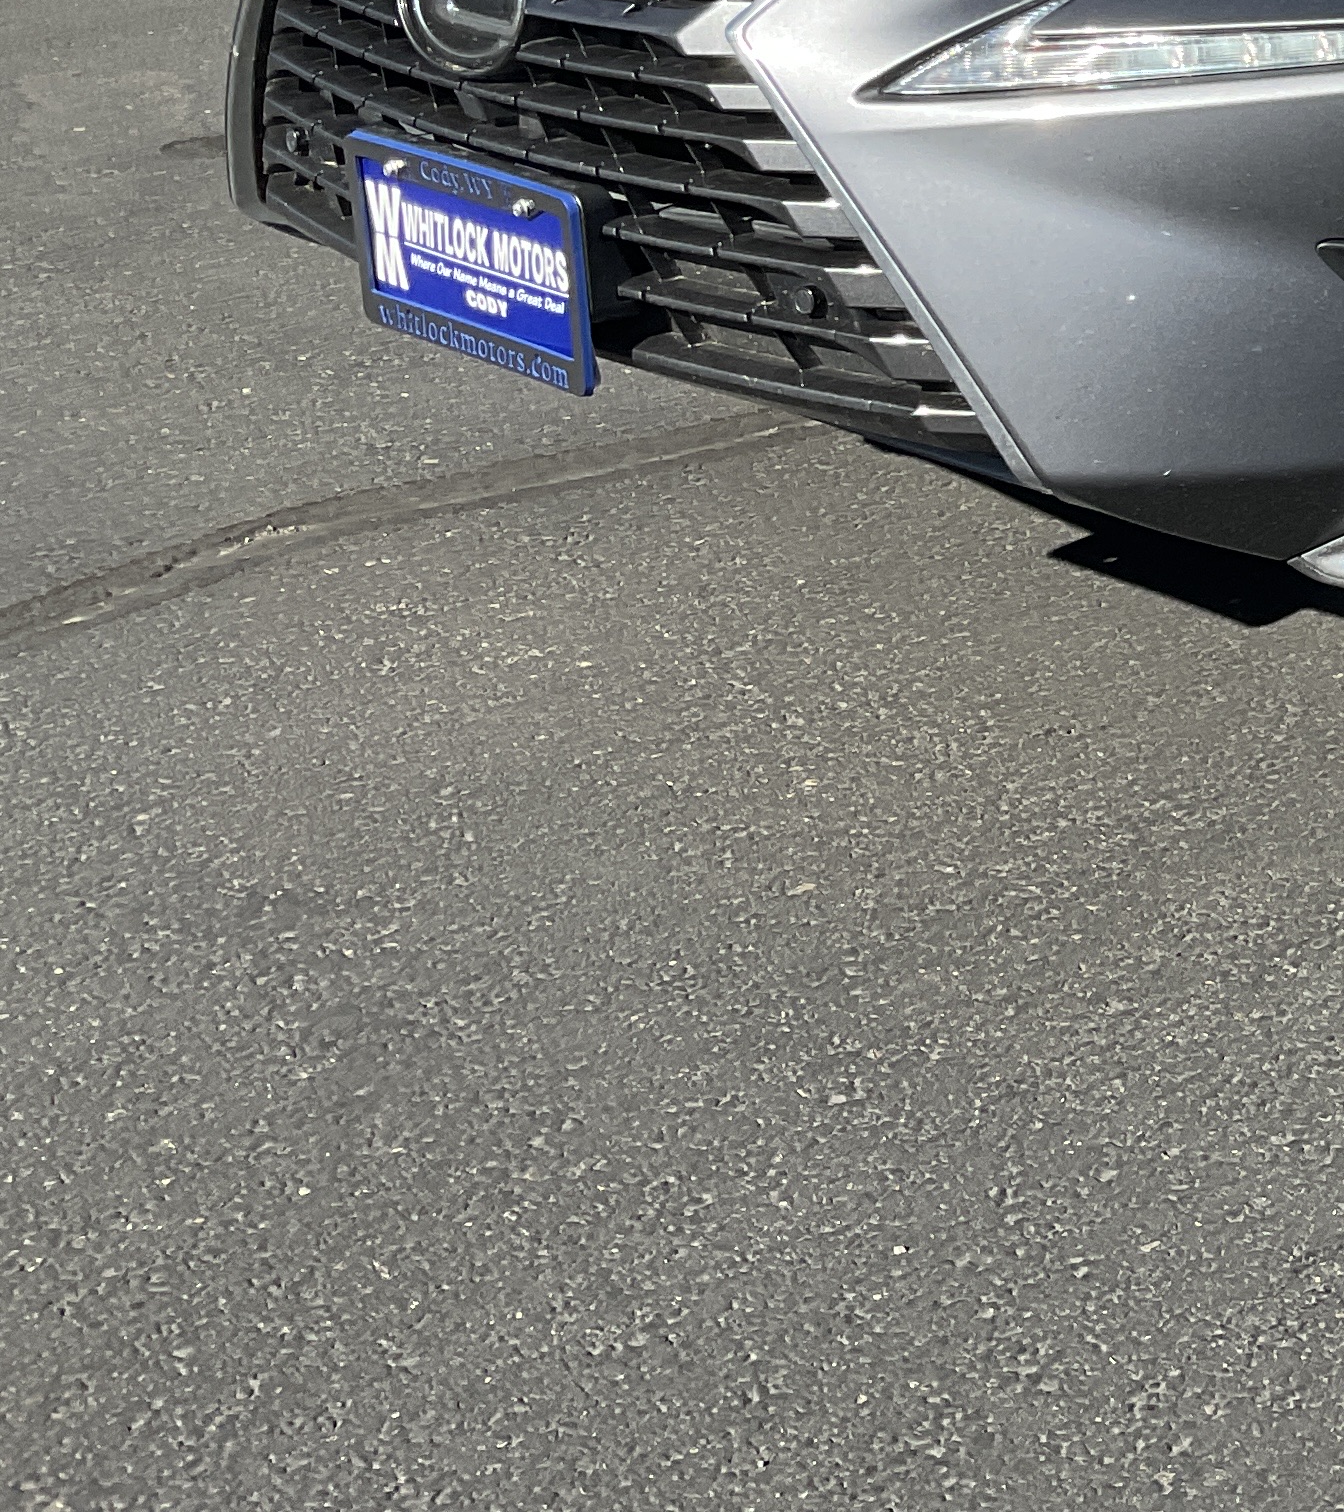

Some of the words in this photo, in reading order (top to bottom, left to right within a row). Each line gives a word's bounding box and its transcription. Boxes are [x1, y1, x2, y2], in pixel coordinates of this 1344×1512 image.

[401, 201, 490, 267] WHITLOCK
[493, 230, 570, 292] MOTORS
[410, 252, 436, 273] Where
[436, 261, 451, 278] Our
[453, 267, 478, 287] Name
[478, 276, 508, 296] Means
[508, 288, 516, 299] a
[516, 289, 543, 309] Great
[544, 297, 565, 315] Deal
[465, 289, 508, 318] CODY
[378, 303, 570, 389] whitlockmotors.com
